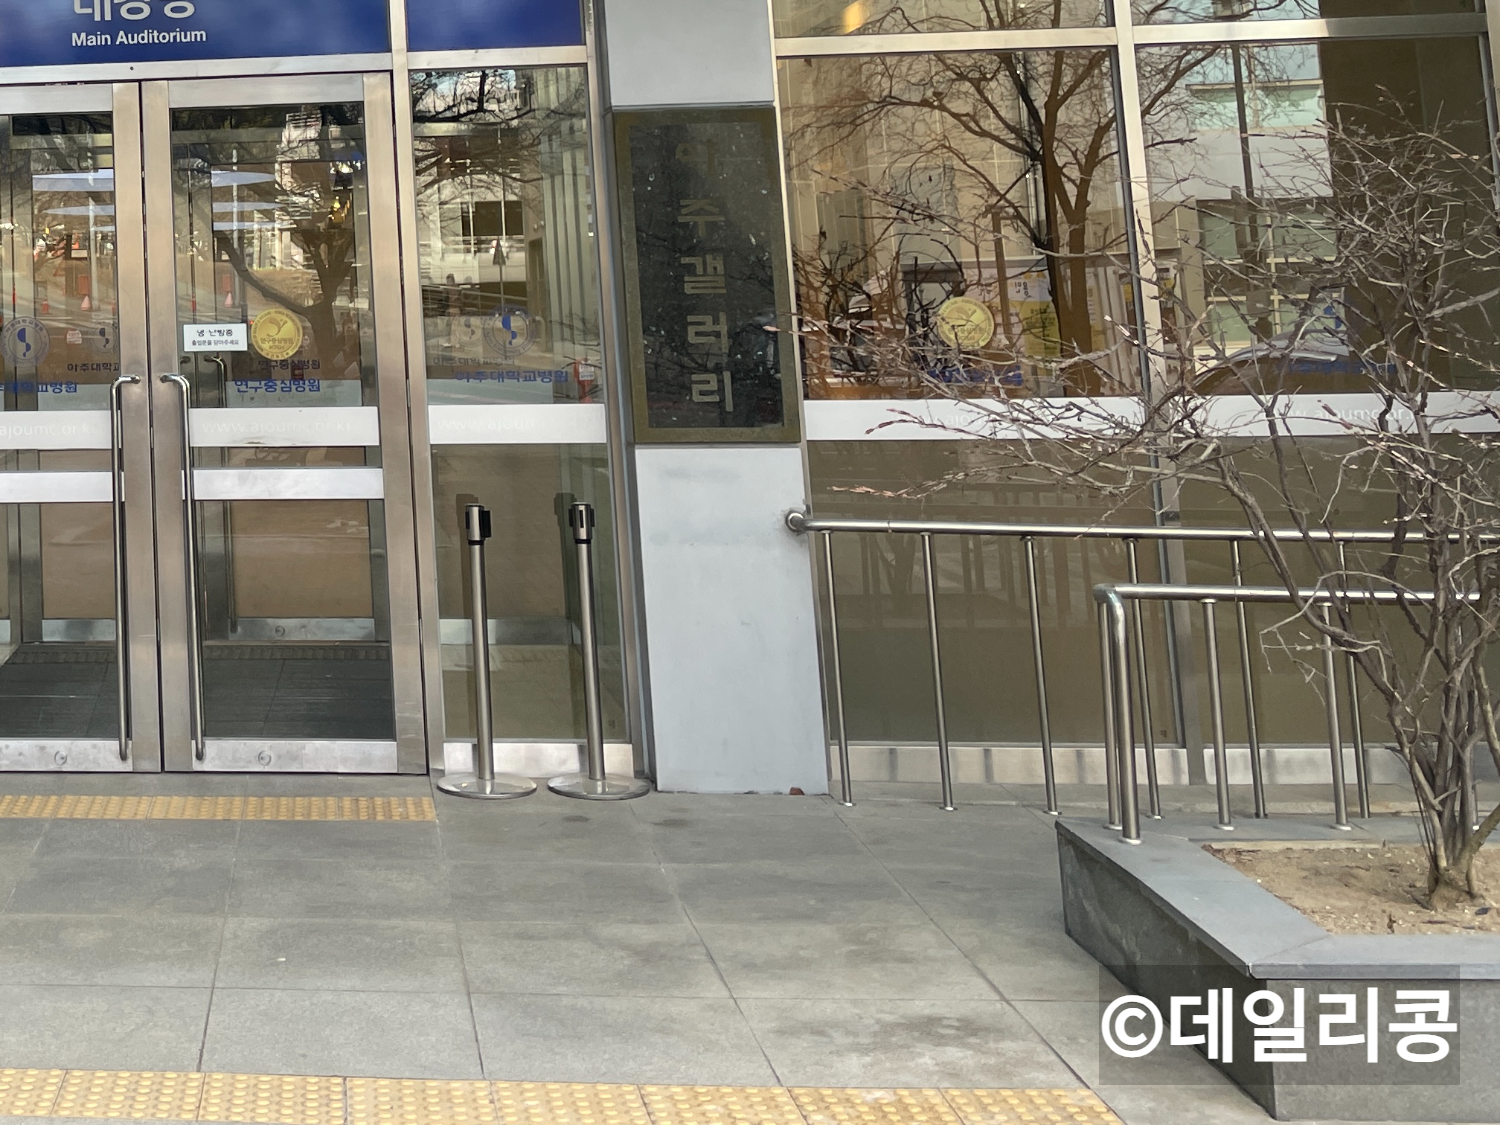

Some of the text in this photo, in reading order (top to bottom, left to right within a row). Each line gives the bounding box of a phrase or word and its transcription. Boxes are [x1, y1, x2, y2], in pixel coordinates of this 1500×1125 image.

[71, 28, 207, 47] Main Auditorium
[675, 138, 734, 412] 아주갤러리
[234, 378, 321, 393] 연구중심병원
